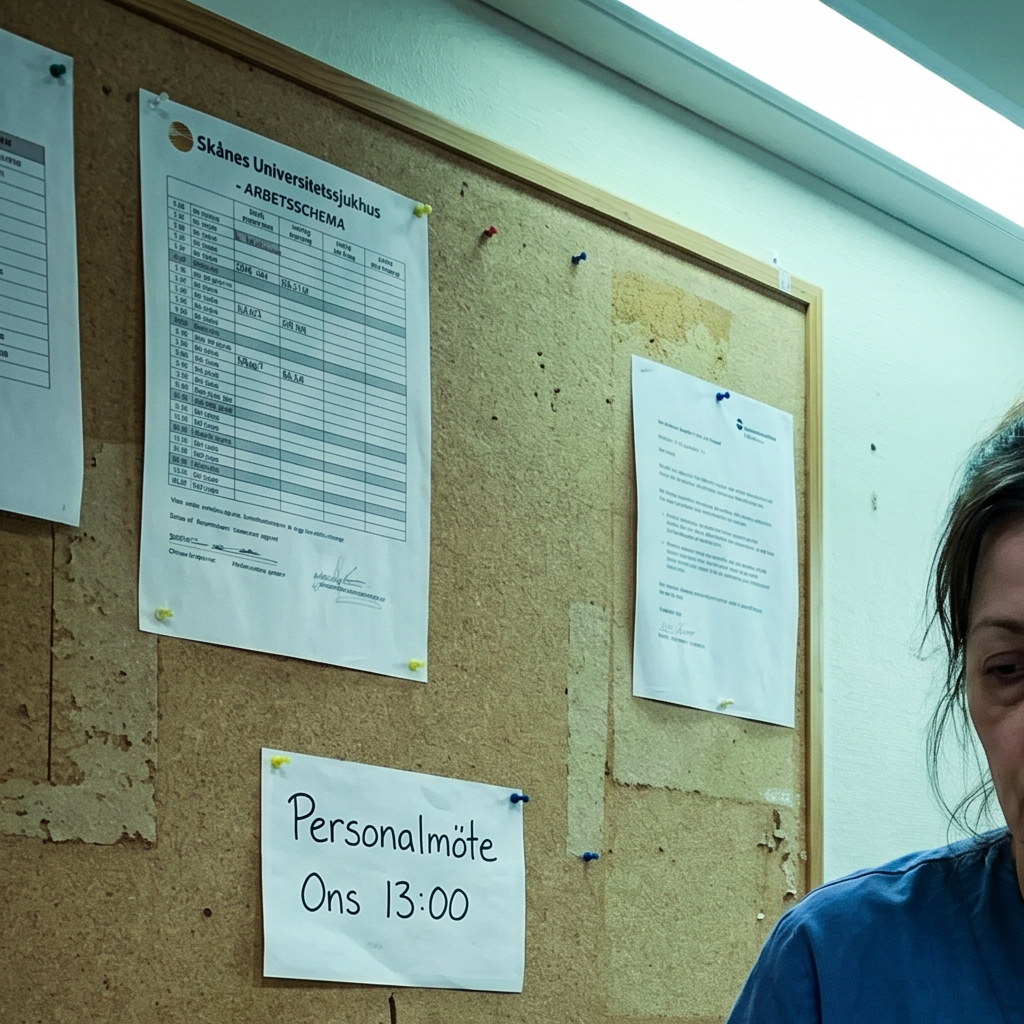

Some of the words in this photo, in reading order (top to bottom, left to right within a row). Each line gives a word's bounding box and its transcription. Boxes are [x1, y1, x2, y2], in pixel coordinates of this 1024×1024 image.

[197, 135, 250, 169] Skånes
[253, 155, 381, 219] Universitetssjukhus
[244, 183, 346, 231] ARBETSSCHEMA
[287, 792, 498, 863] Personalmöte
[301, 872, 361, 916] Ons
[386, 880, 470, 922] 13:00
